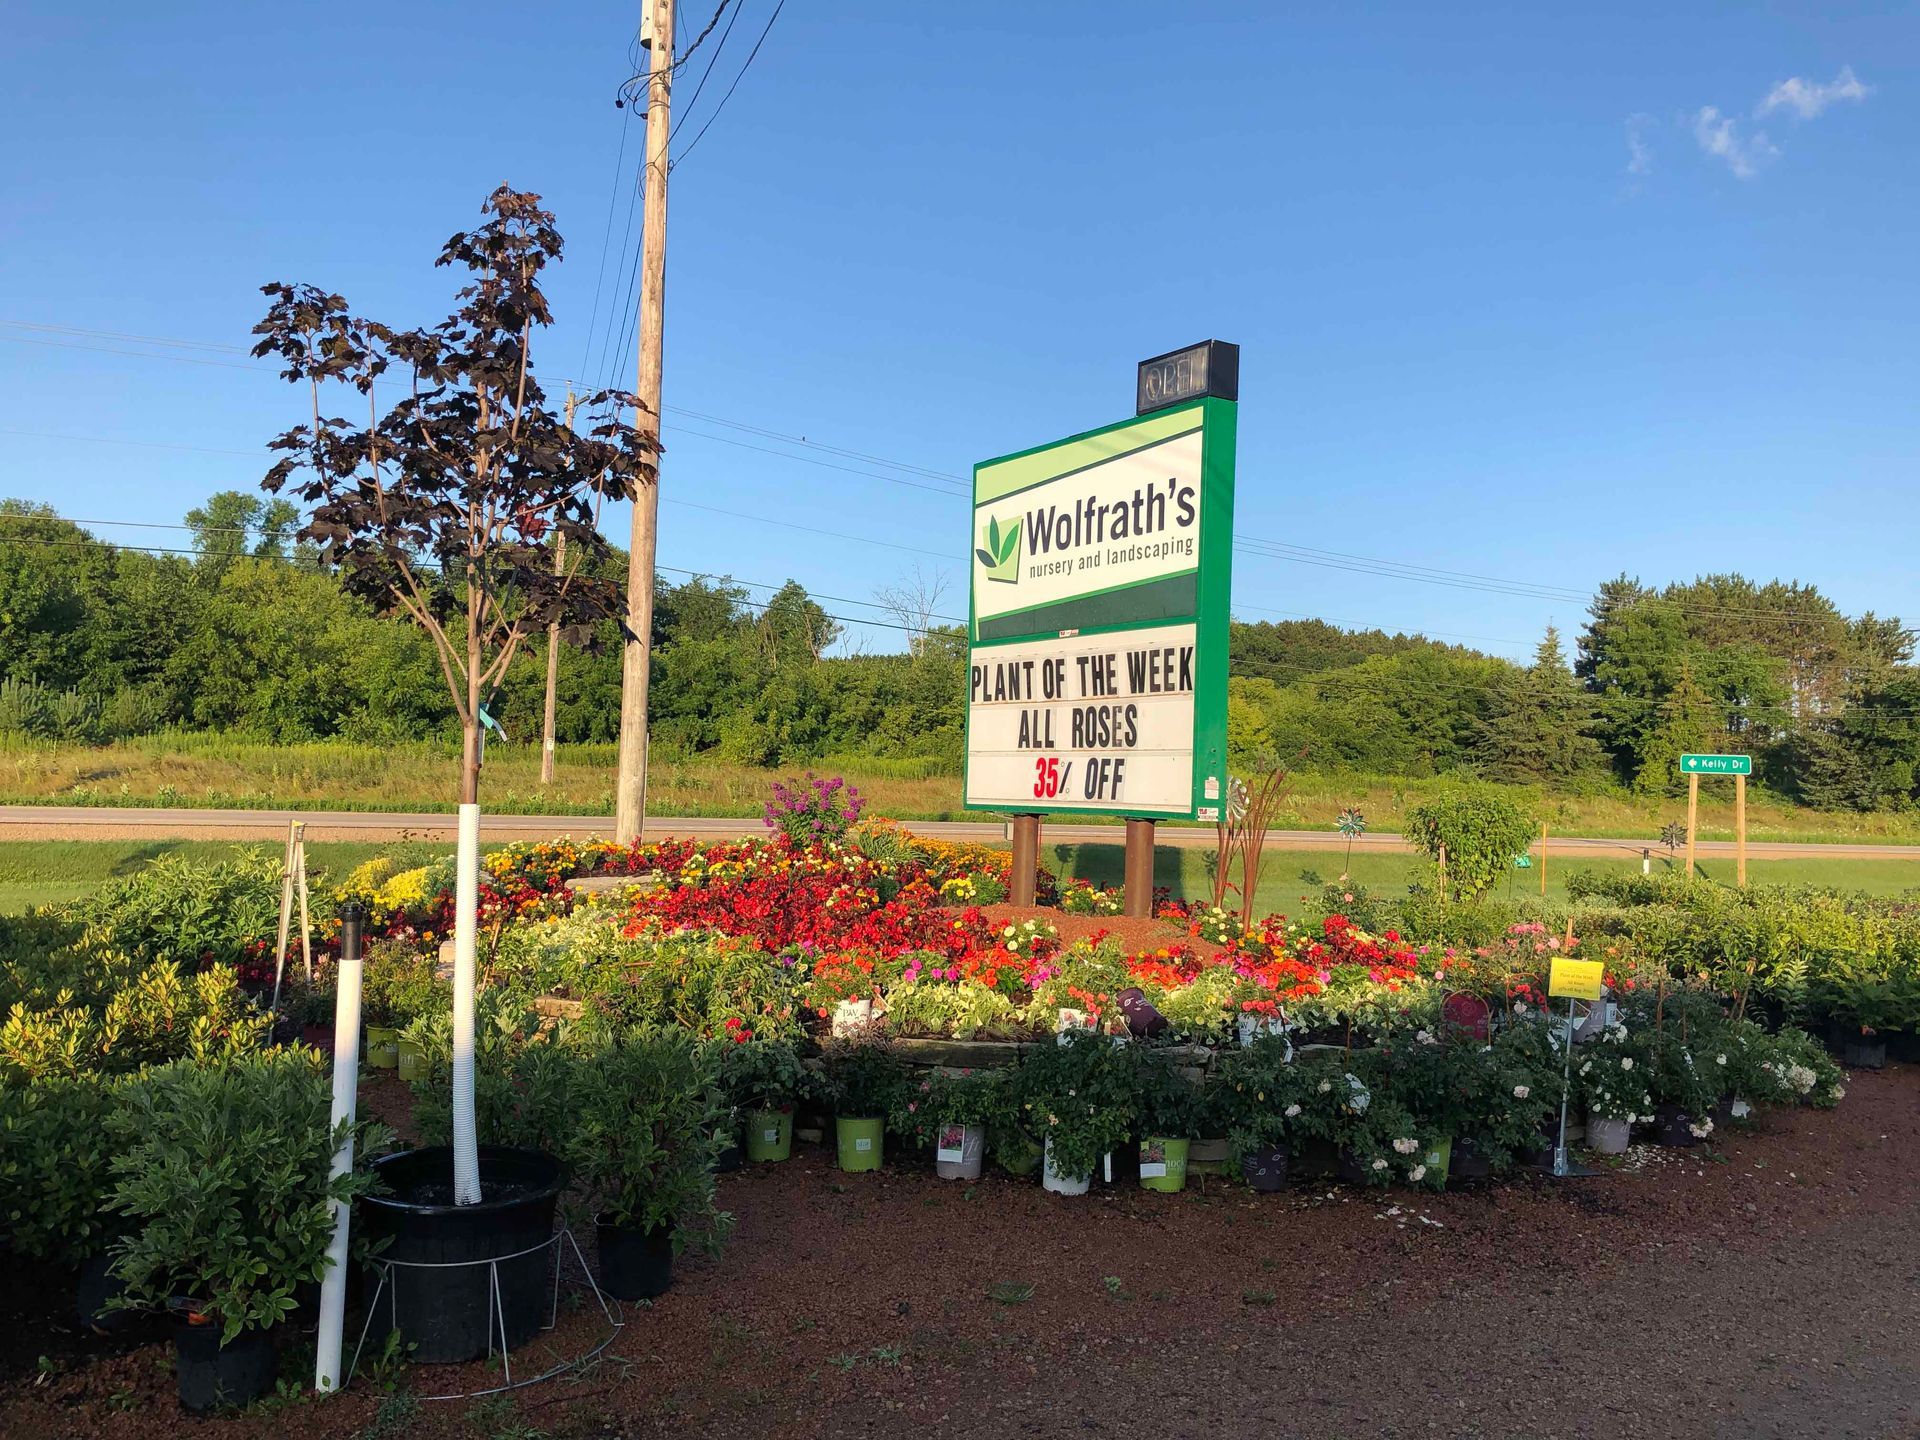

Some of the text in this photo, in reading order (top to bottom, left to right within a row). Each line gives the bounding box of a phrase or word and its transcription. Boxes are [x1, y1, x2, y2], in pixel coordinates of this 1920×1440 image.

[1026, 478, 1196, 556] Wolfrath's
[1029, 537, 1194, 579] nursery and landscaping
[971, 646, 1194, 702] PLANT OF THE WEEK
[1018, 704, 1138, 749] ALL ROSES
[1084, 757, 1125, 800] OFF
[1701, 759, 1744, 771] Kelly Dr
